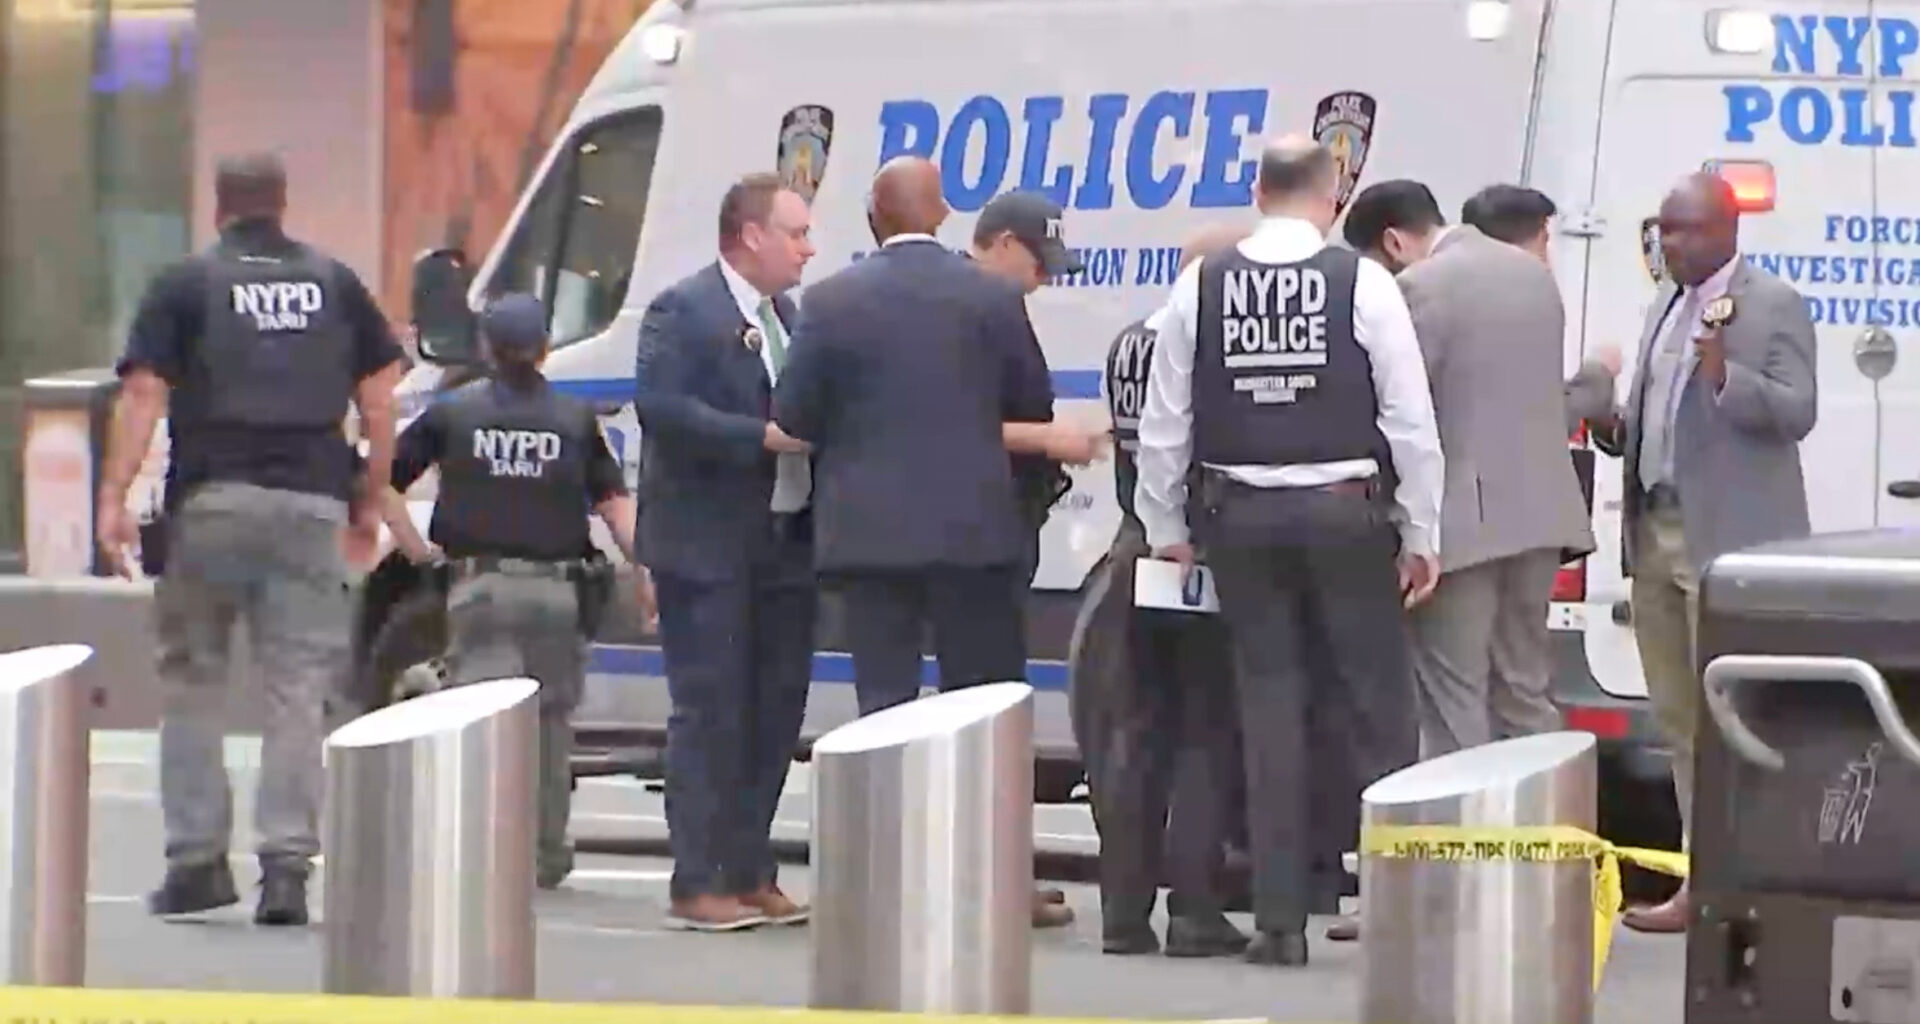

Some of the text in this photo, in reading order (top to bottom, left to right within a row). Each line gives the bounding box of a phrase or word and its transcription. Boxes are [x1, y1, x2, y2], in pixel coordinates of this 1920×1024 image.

[1722, 84, 1917, 147] POLI
[877, 88, 1269, 215] POLICE
[232, 282, 323, 314] NYPD
[1223, 268, 1327, 317] NYPD
[1223, 315, 1328, 354] POLICE
[473, 428, 561, 461] NYPD
